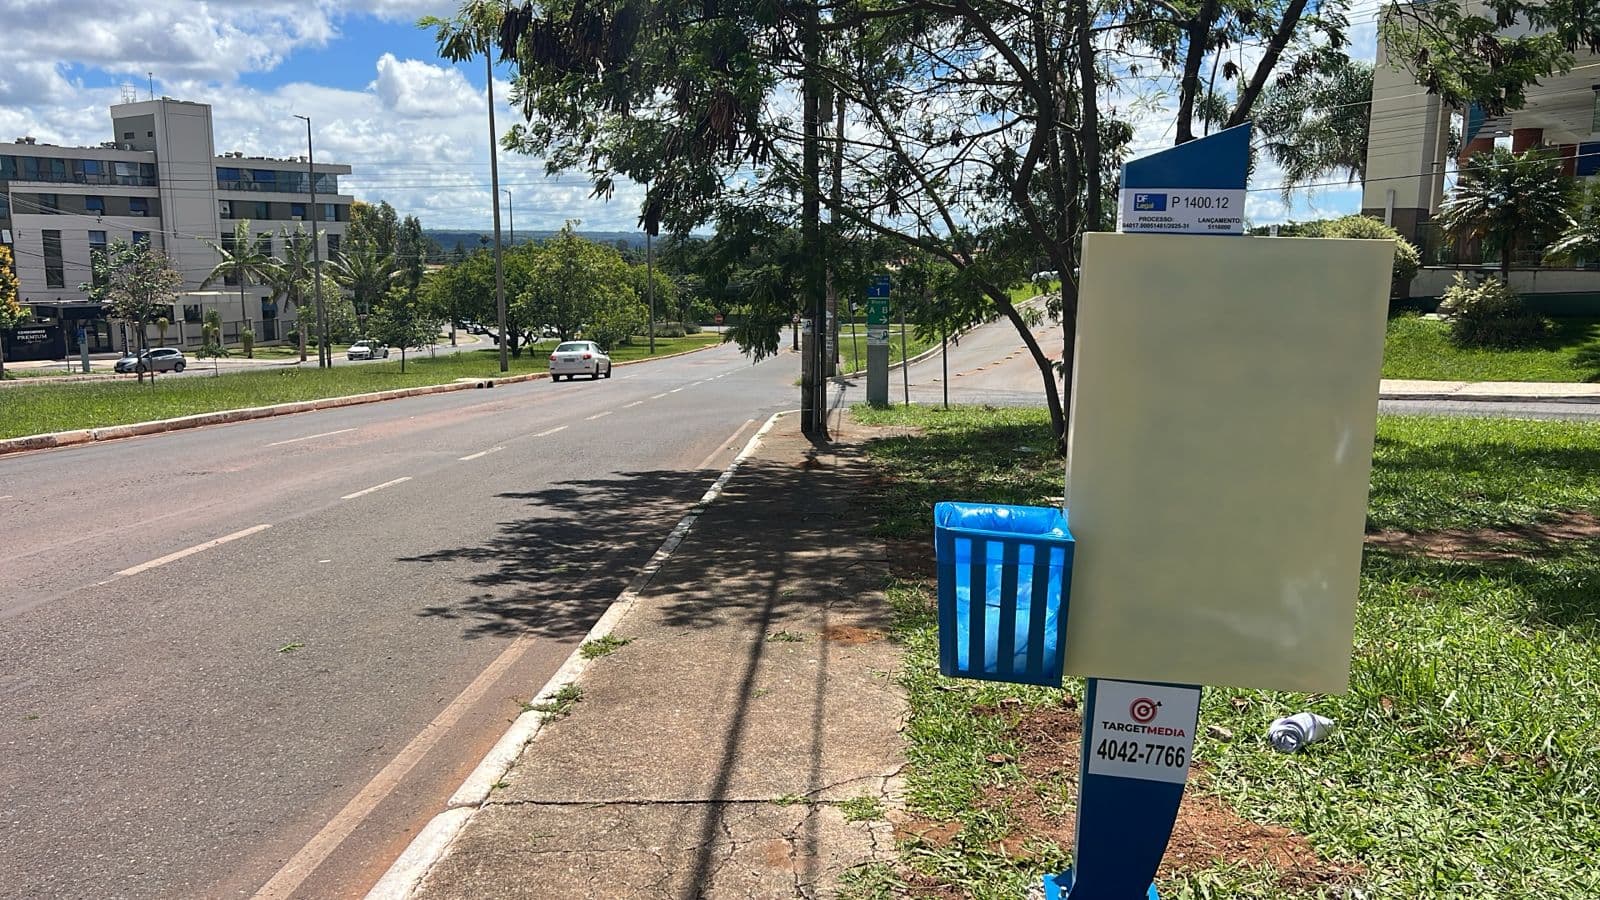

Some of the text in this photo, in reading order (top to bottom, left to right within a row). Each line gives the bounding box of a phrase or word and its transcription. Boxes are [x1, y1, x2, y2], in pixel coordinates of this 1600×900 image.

[1136, 194, 1149, 202] DF
[1171, 196, 1228, 208] P 1400.12
[1102, 721, 1186, 738] TARGETMEDIA
[1097, 738, 1186, 768] 4042-7766
